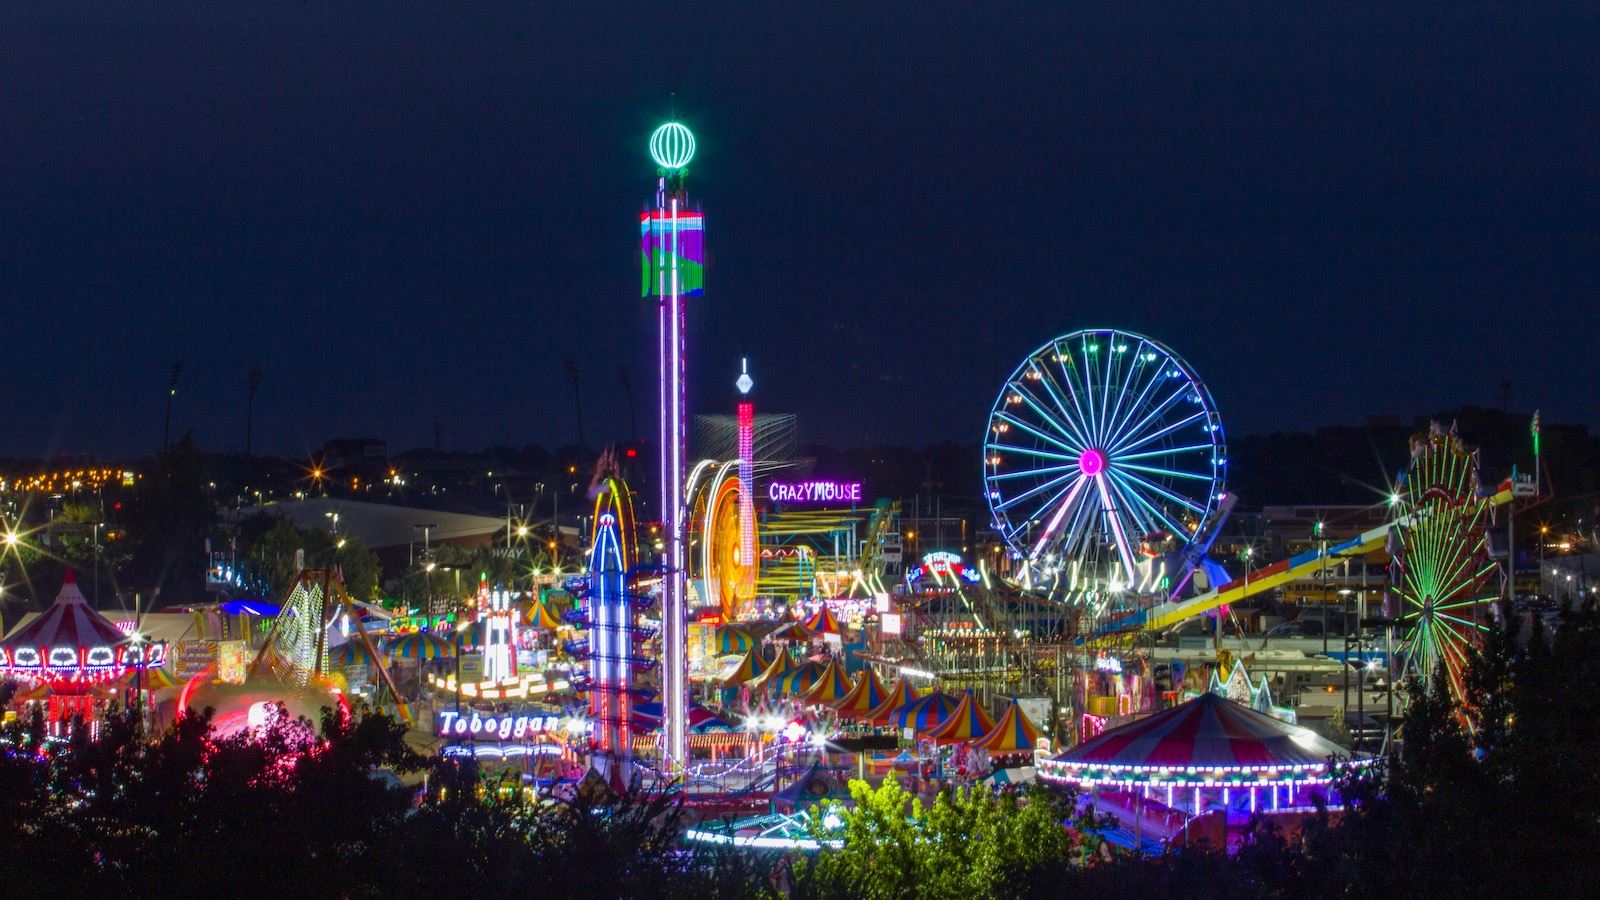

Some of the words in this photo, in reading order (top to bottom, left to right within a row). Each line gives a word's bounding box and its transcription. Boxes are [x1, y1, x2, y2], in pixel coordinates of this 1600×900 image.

[769, 482, 814, 500] CRAZY
[814, 482, 860, 500] MOUSE
[440, 711, 559, 739] Toboggan
